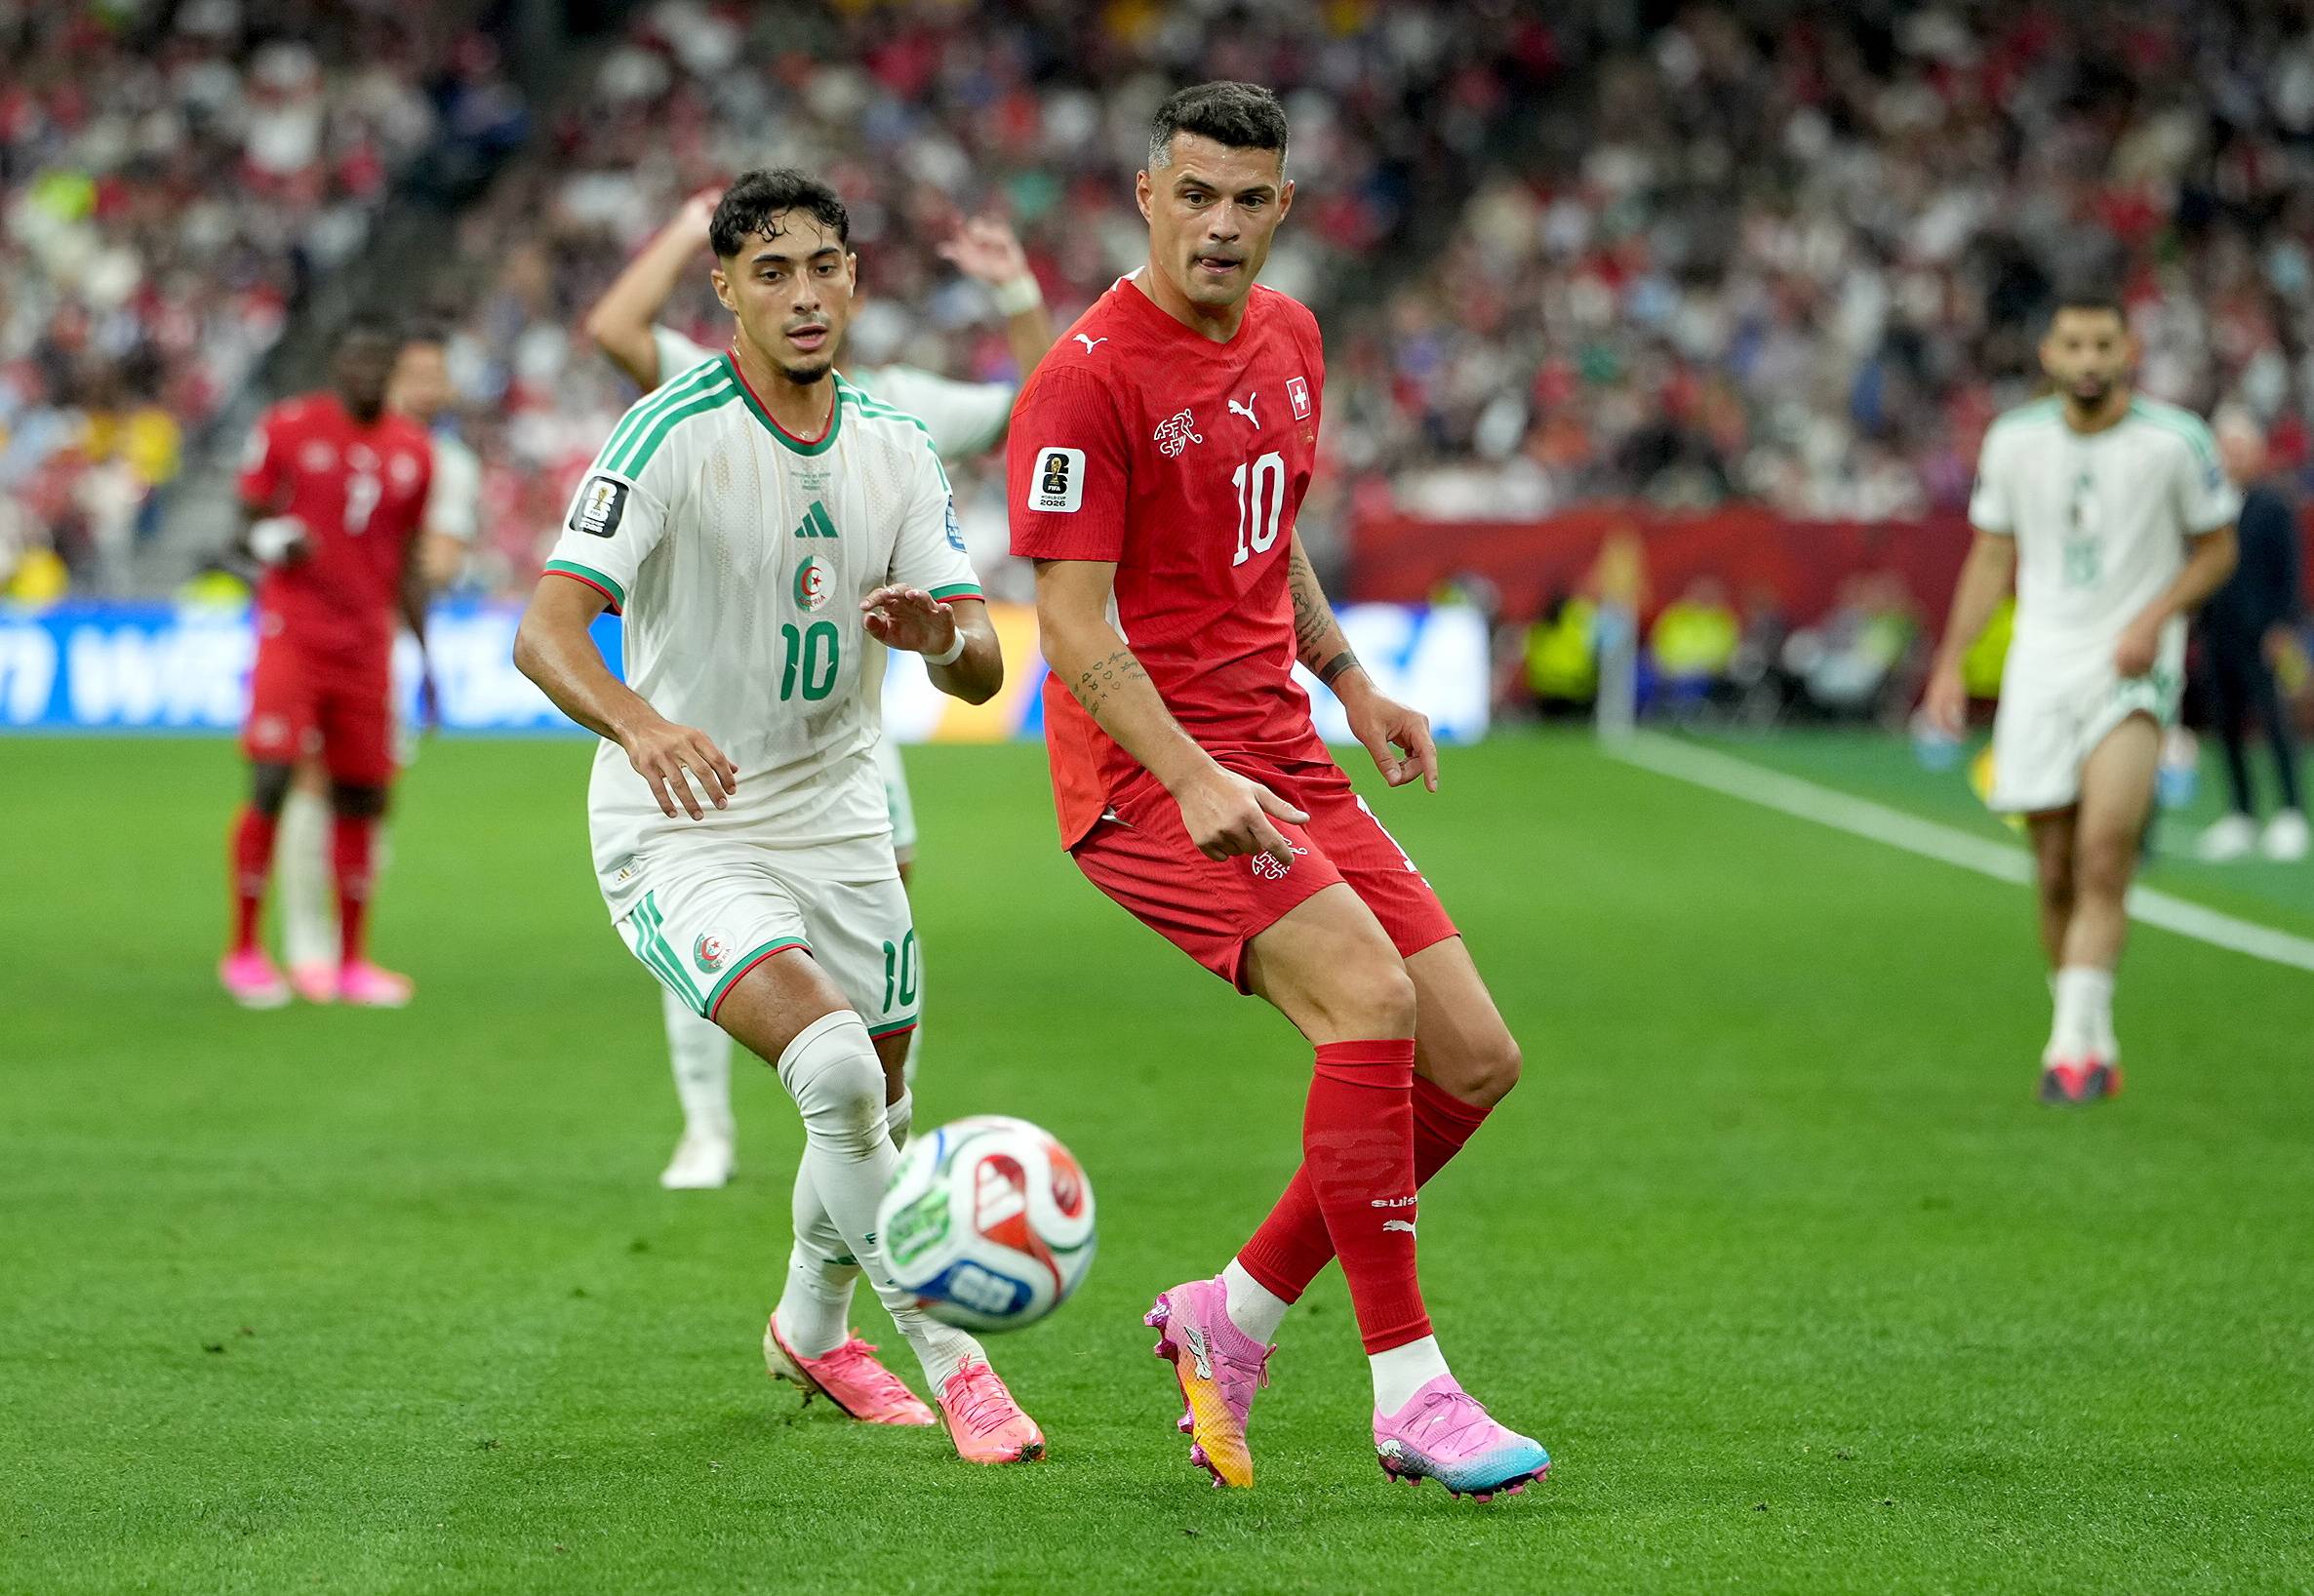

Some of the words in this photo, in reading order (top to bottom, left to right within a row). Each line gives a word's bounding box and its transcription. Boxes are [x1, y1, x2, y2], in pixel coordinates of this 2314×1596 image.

[1040, 499, 1066, 507] 2026
[1232, 451, 1285, 566] 10
[780, 620, 840, 701] 10
[883, 928, 917, 1015] 10
[1201, 1326, 1214, 1355] FUTURE
